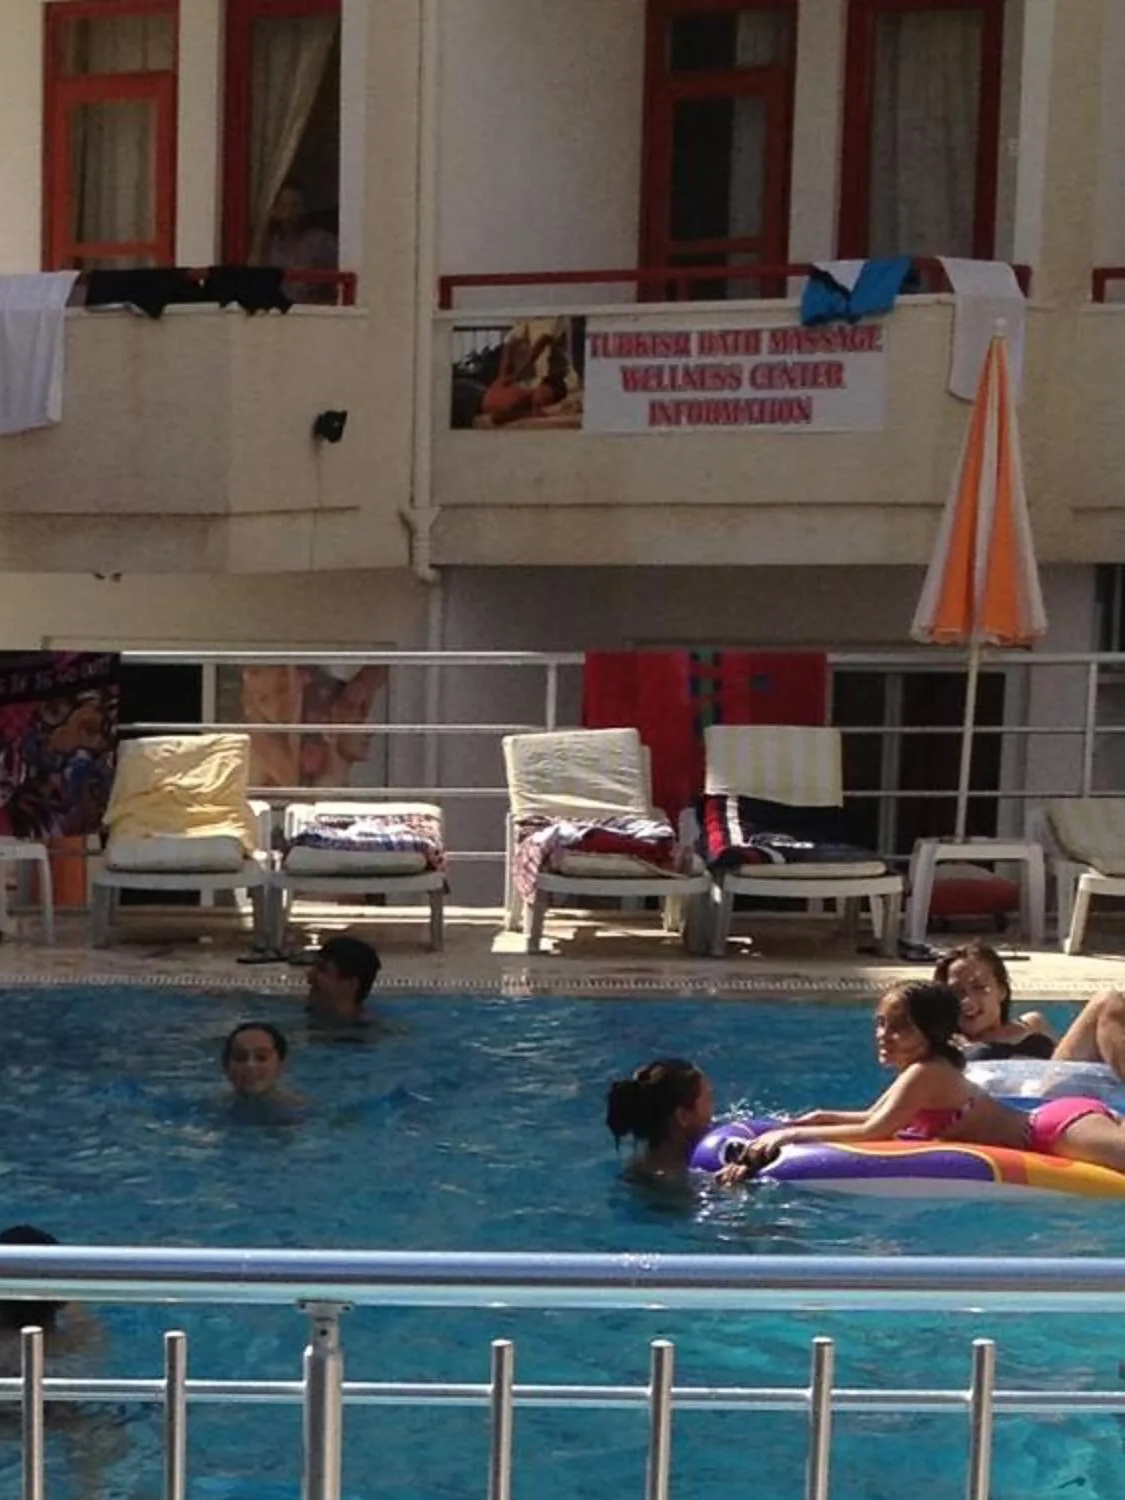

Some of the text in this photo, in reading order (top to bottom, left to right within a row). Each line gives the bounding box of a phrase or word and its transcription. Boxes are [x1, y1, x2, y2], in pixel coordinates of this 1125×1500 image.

[587, 324, 883, 359] TURKISH BATH MASSAGE
[619, 360, 848, 392] WELLNESS CENTER
[648, 396, 812, 427] INFORMATION
